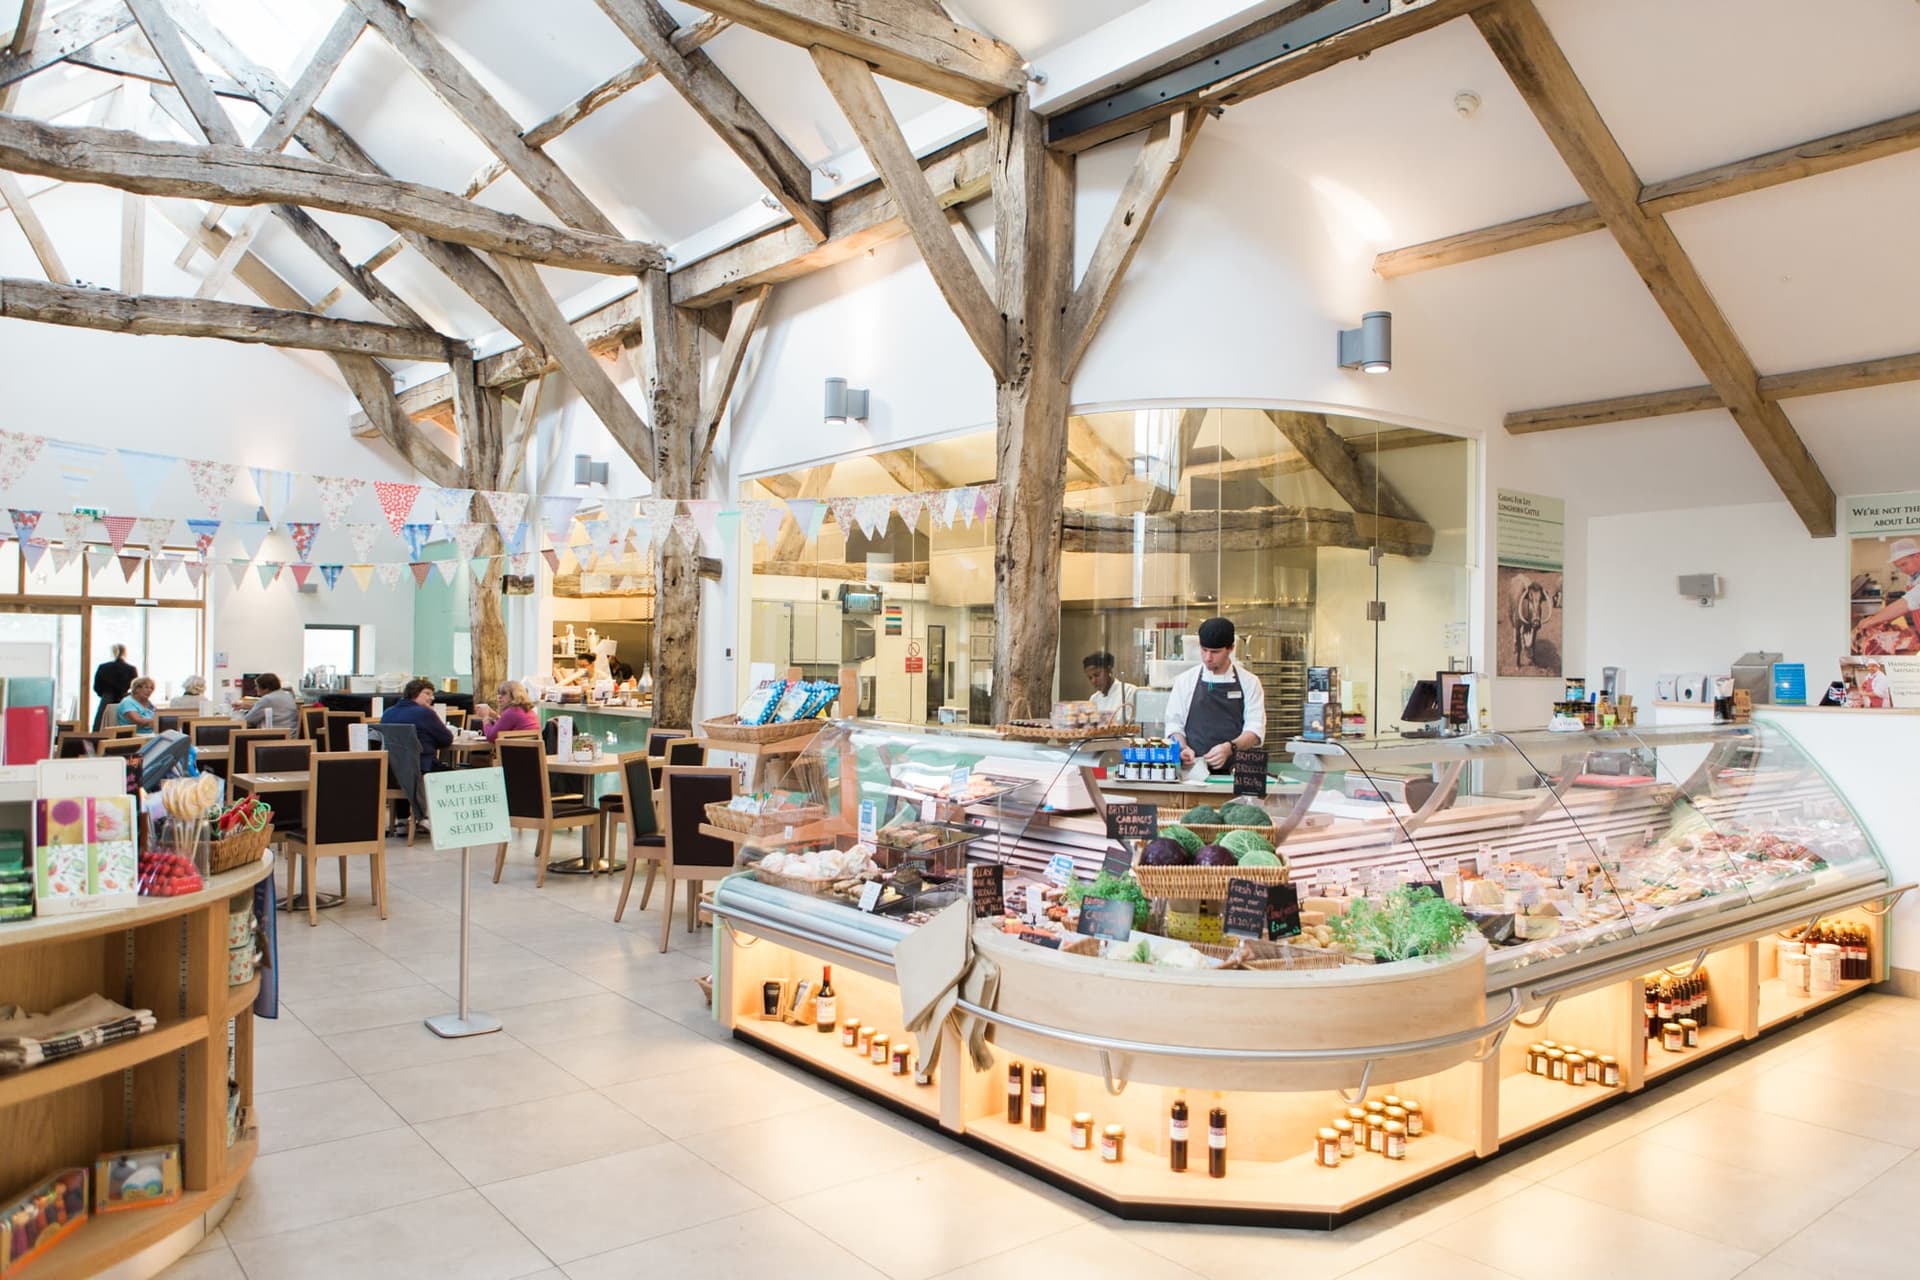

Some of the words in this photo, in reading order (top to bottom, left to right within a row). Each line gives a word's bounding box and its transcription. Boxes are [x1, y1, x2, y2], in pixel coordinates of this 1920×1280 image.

[1873, 518, 1902, 527] ABOUT
[445, 780, 488, 794] PLEASE
[437, 796, 466, 808] WAIT
[469, 793, 499, 805] HERE
[453, 810, 469, 820] TO
[472, 808, 488, 819] BE
[449, 821, 494, 835] SEATED
